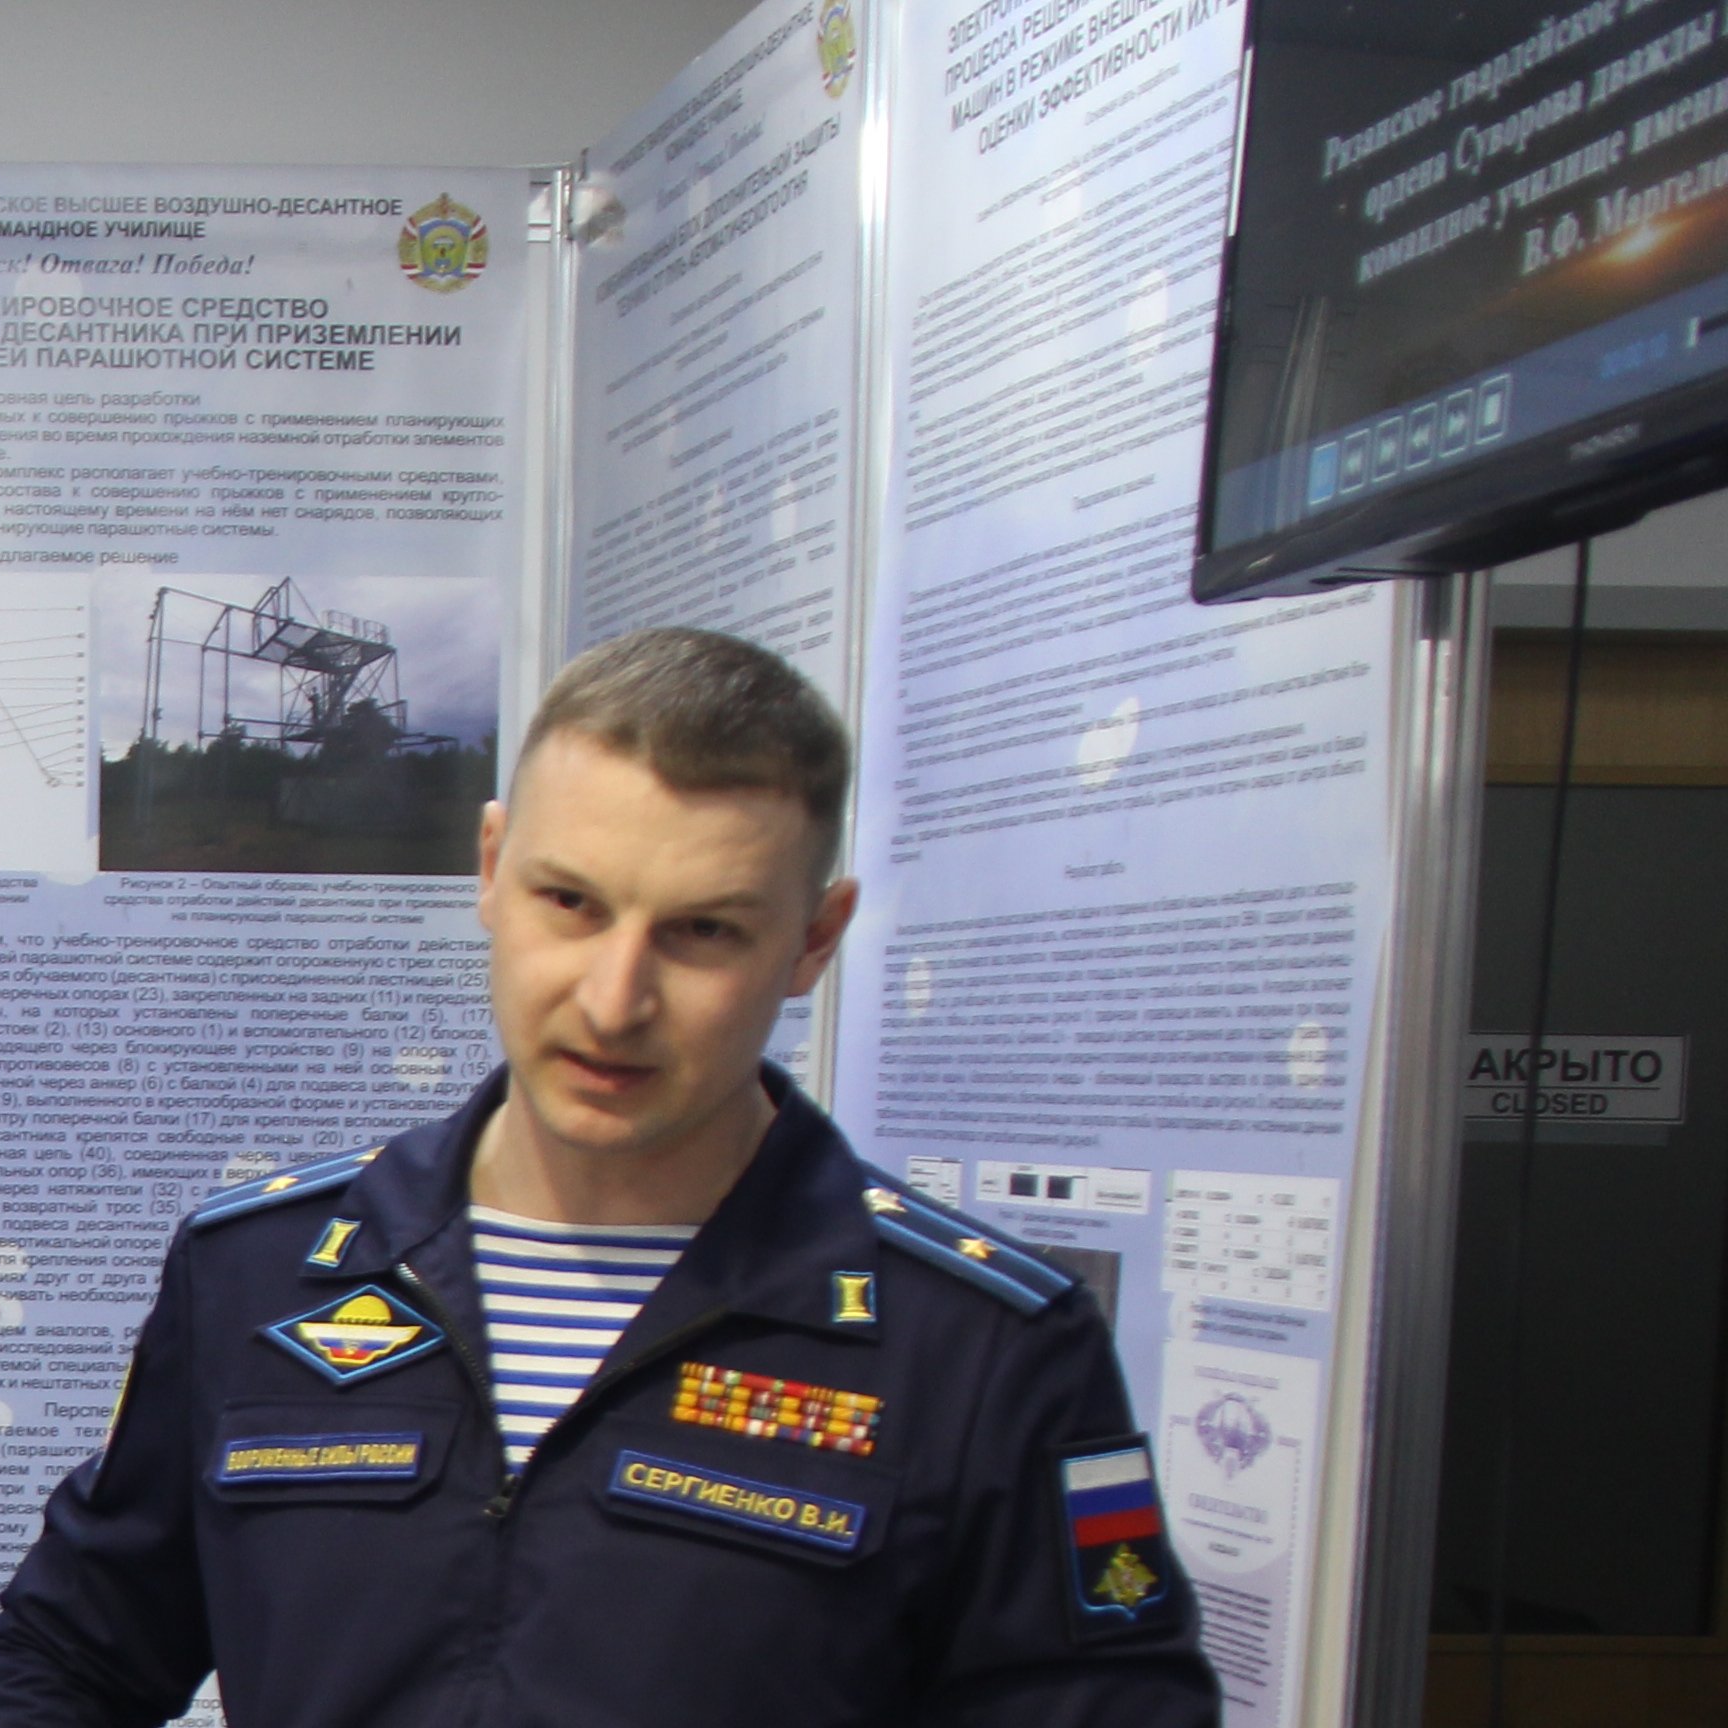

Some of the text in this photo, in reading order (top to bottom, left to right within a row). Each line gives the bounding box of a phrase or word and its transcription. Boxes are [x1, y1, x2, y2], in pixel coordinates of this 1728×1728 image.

[944, 25, 1019, 96] ПРОЦЕССА
[1005, 66, 1017, 98] В
[1020, 22, 1085, 89] РЕЖИМЕ
[979, 95, 1037, 155] ОЦЕНКИ
[1038, 6, 1184, 120] ЭФФЕКТИВНОСТИ
[54, 197, 148, 214] ВЫСШЕЕ
[154, 197, 405, 218] ВОЗДУШНО-ДЕСАНТНОЕ
[104, 220, 207, 240] УЧИЛИЩЕ
[39, 252, 145, 275] Отвага!
[151, 252, 256, 276] Победа!
[181, 296, 330, 320] СРЕДСТВО
[0, 321, 185, 344] ДЕСАНТНИКА
[193, 322, 248, 347] ПРИ
[255, 323, 462, 346] ПРИЗЕМЛЕНИИ
[36, 346, 237, 369] ПАРАШЮТНОЙ
[244, 348, 376, 371] СИСТЕМЕ
[52, 392, 96, 406] цель
[99, 390, 202, 408] разработки
[98, 550, 180, 565] решение
[1491, 1092, 1609, 1115] CLOSED
[624, 1462, 855, 1536] СЕРГИЕНКО В.И.
